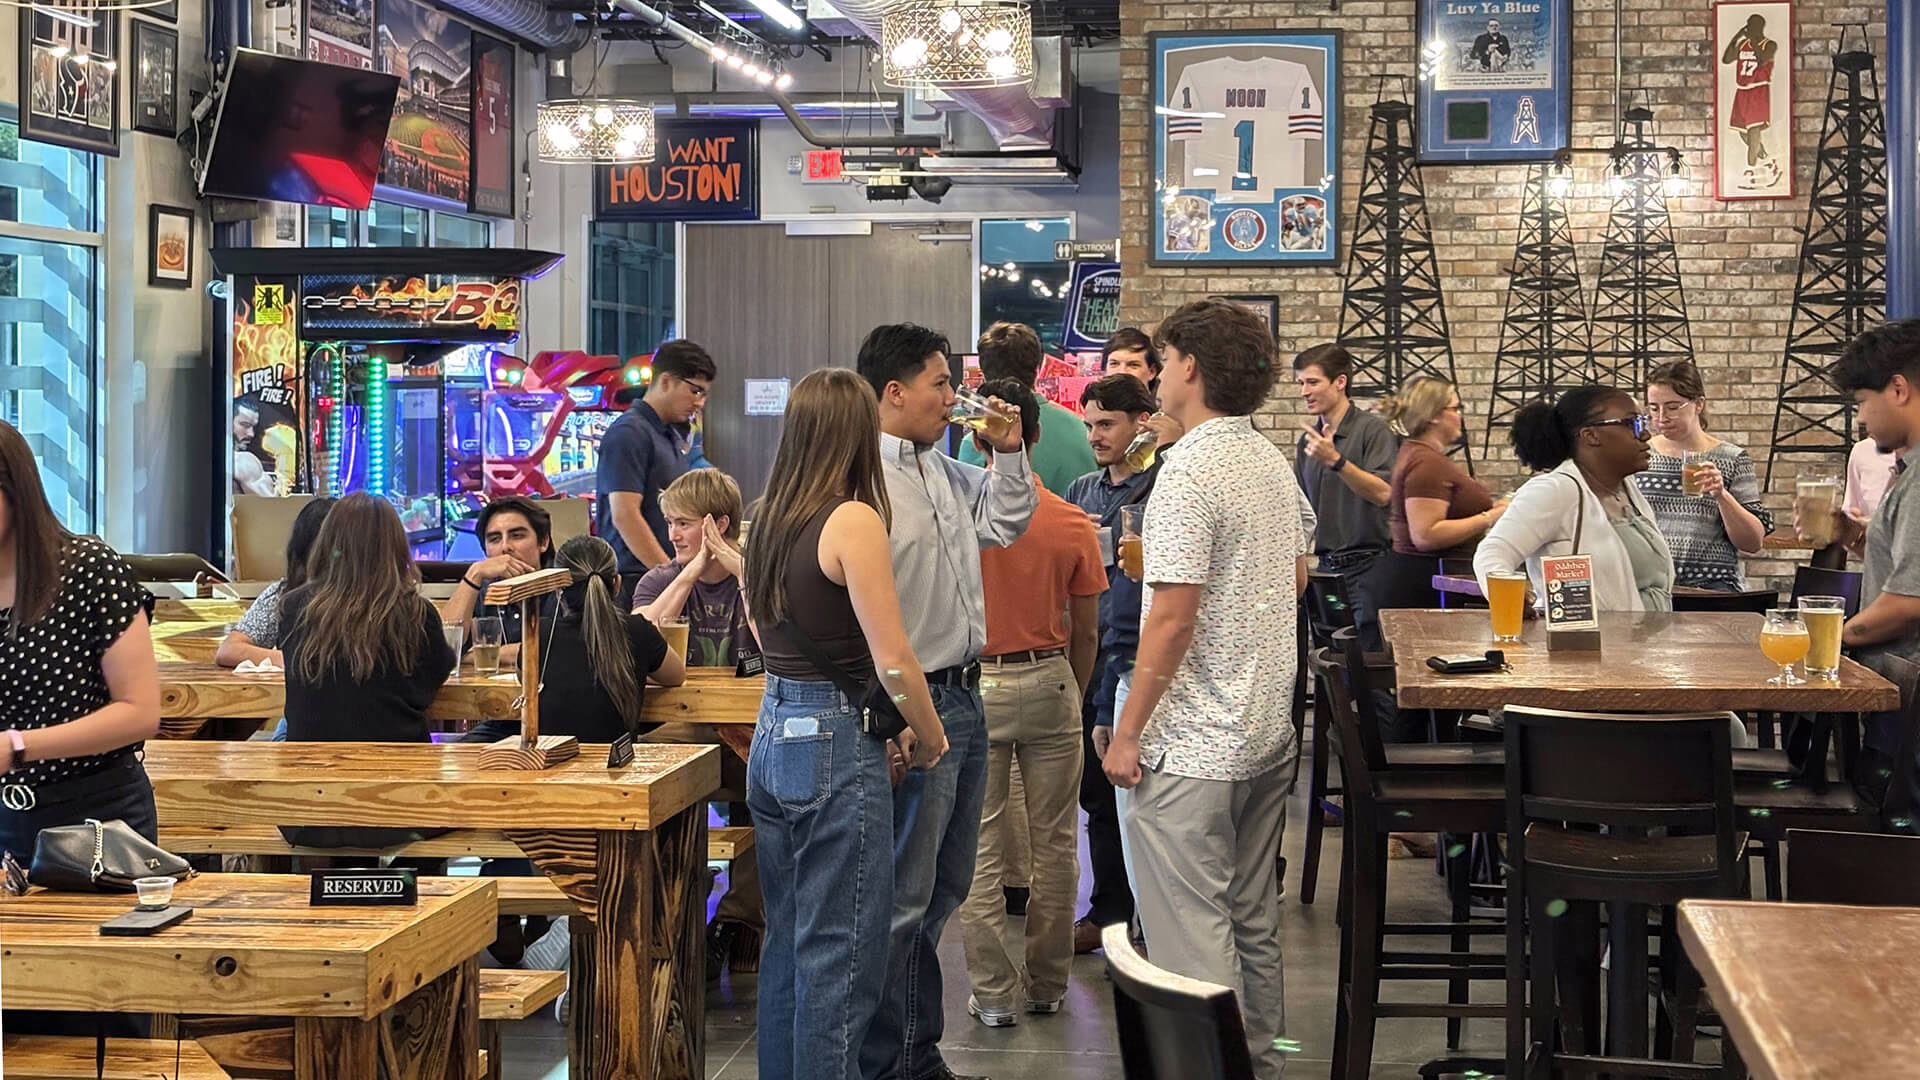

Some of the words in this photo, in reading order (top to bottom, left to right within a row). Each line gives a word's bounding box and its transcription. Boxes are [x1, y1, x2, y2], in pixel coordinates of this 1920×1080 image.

[1447, 3, 1477, 15] Luv
[1481, 3, 1500, 14] Ya
[1504, 2, 1540, 13] Blue
[1740, 60, 1758, 76] 17
[1182, 87, 1192, 108] 1
[1225, 88, 1266, 108] MOON
[1301, 87, 1311, 108] 1
[489, 97, 496, 135] 5
[667, 136, 735, 163] WANT
[1232, 120, 1257, 191] 1
[610, 163, 741, 204] HOUSTON!
[323, 880, 404, 894] RESERVED
